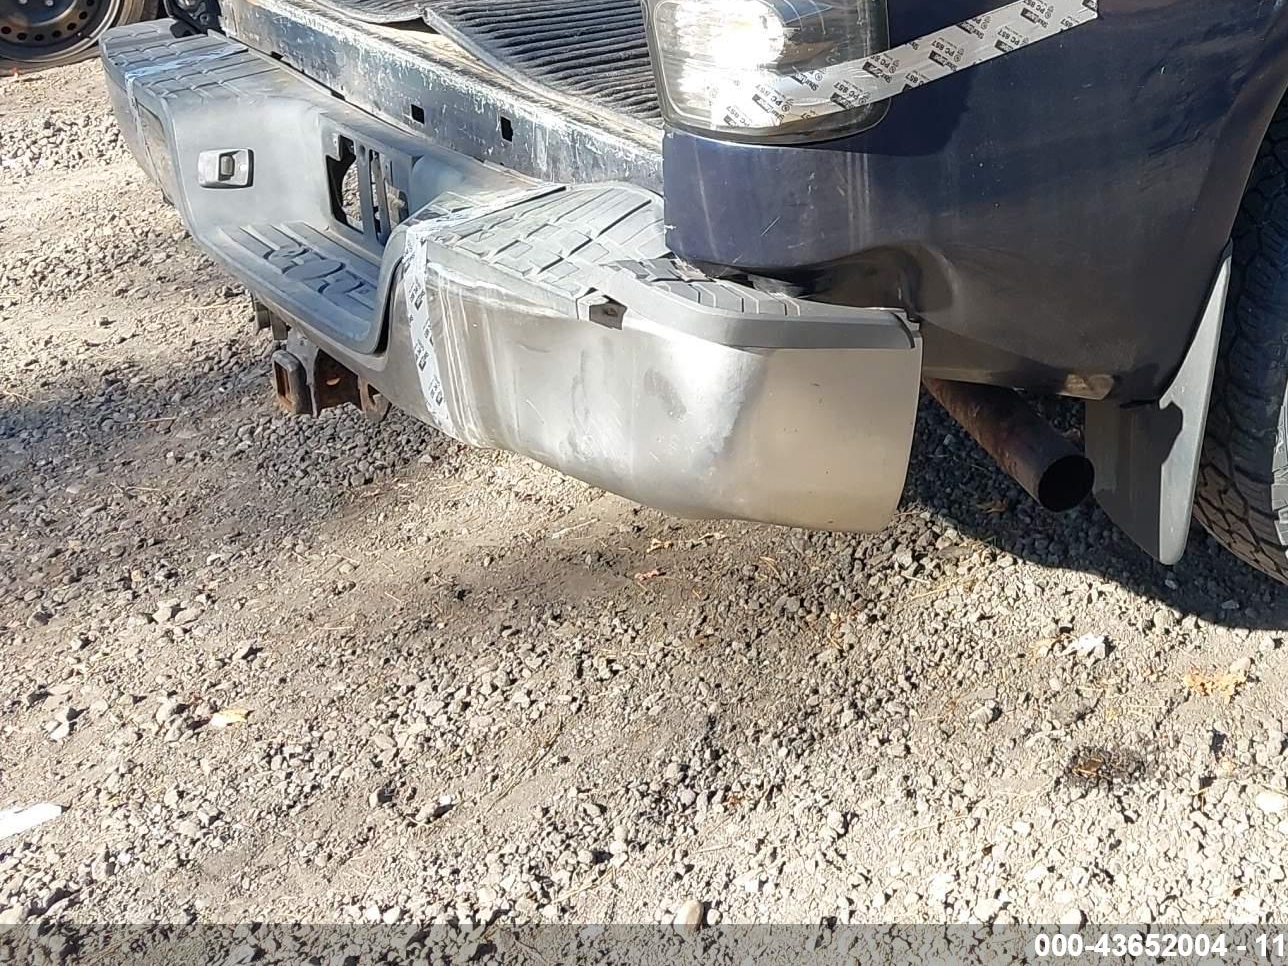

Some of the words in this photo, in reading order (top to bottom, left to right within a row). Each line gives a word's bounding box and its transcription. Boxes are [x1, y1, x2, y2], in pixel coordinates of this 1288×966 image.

[1034, 3, 1045, 13] PC
[997, 29, 1010, 40] 857
[931, 39, 944, 51] 857
[1008, 35, 1020, 45] PC
[943, 46, 954, 56] PC
[879, 59, 889, 68] PC
[905, 72, 919, 84] 857
[833, 81, 848, 94] 857
[847, 88, 860, 100] PC
[770, 96, 783, 106] PC
